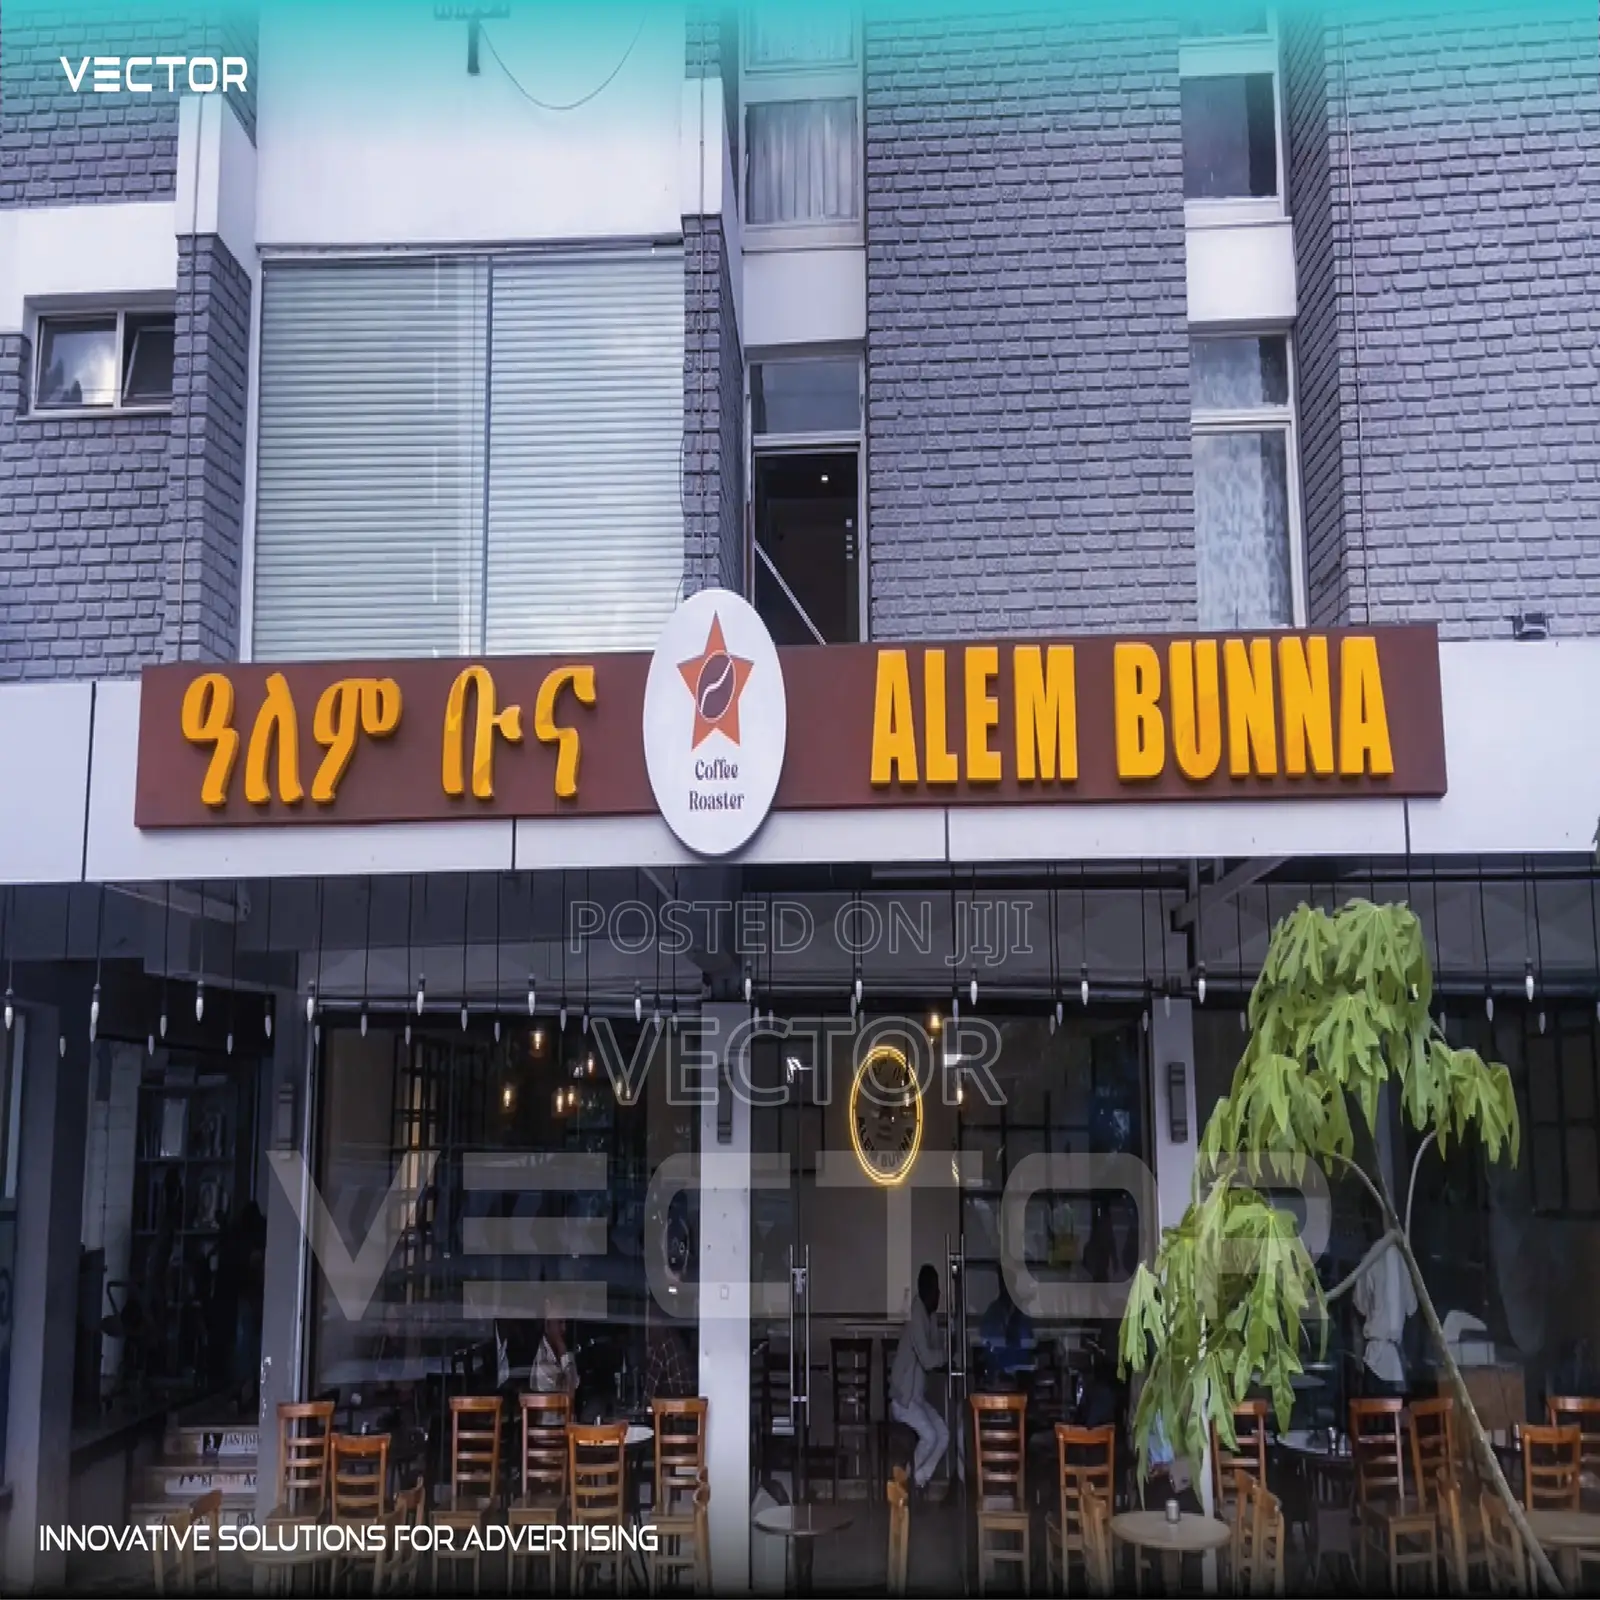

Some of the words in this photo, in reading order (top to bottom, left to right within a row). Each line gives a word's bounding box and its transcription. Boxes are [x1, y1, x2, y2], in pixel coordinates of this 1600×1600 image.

[181, 672, 403, 807] ዓለም
[441, 664, 598, 800] ቡና
[870, 643, 1079, 785] ALEM
[1113, 635, 1395, 782] BUNNA
[689, 789, 745, 810] Roaster
[694, 757, 739, 781] Coffee
